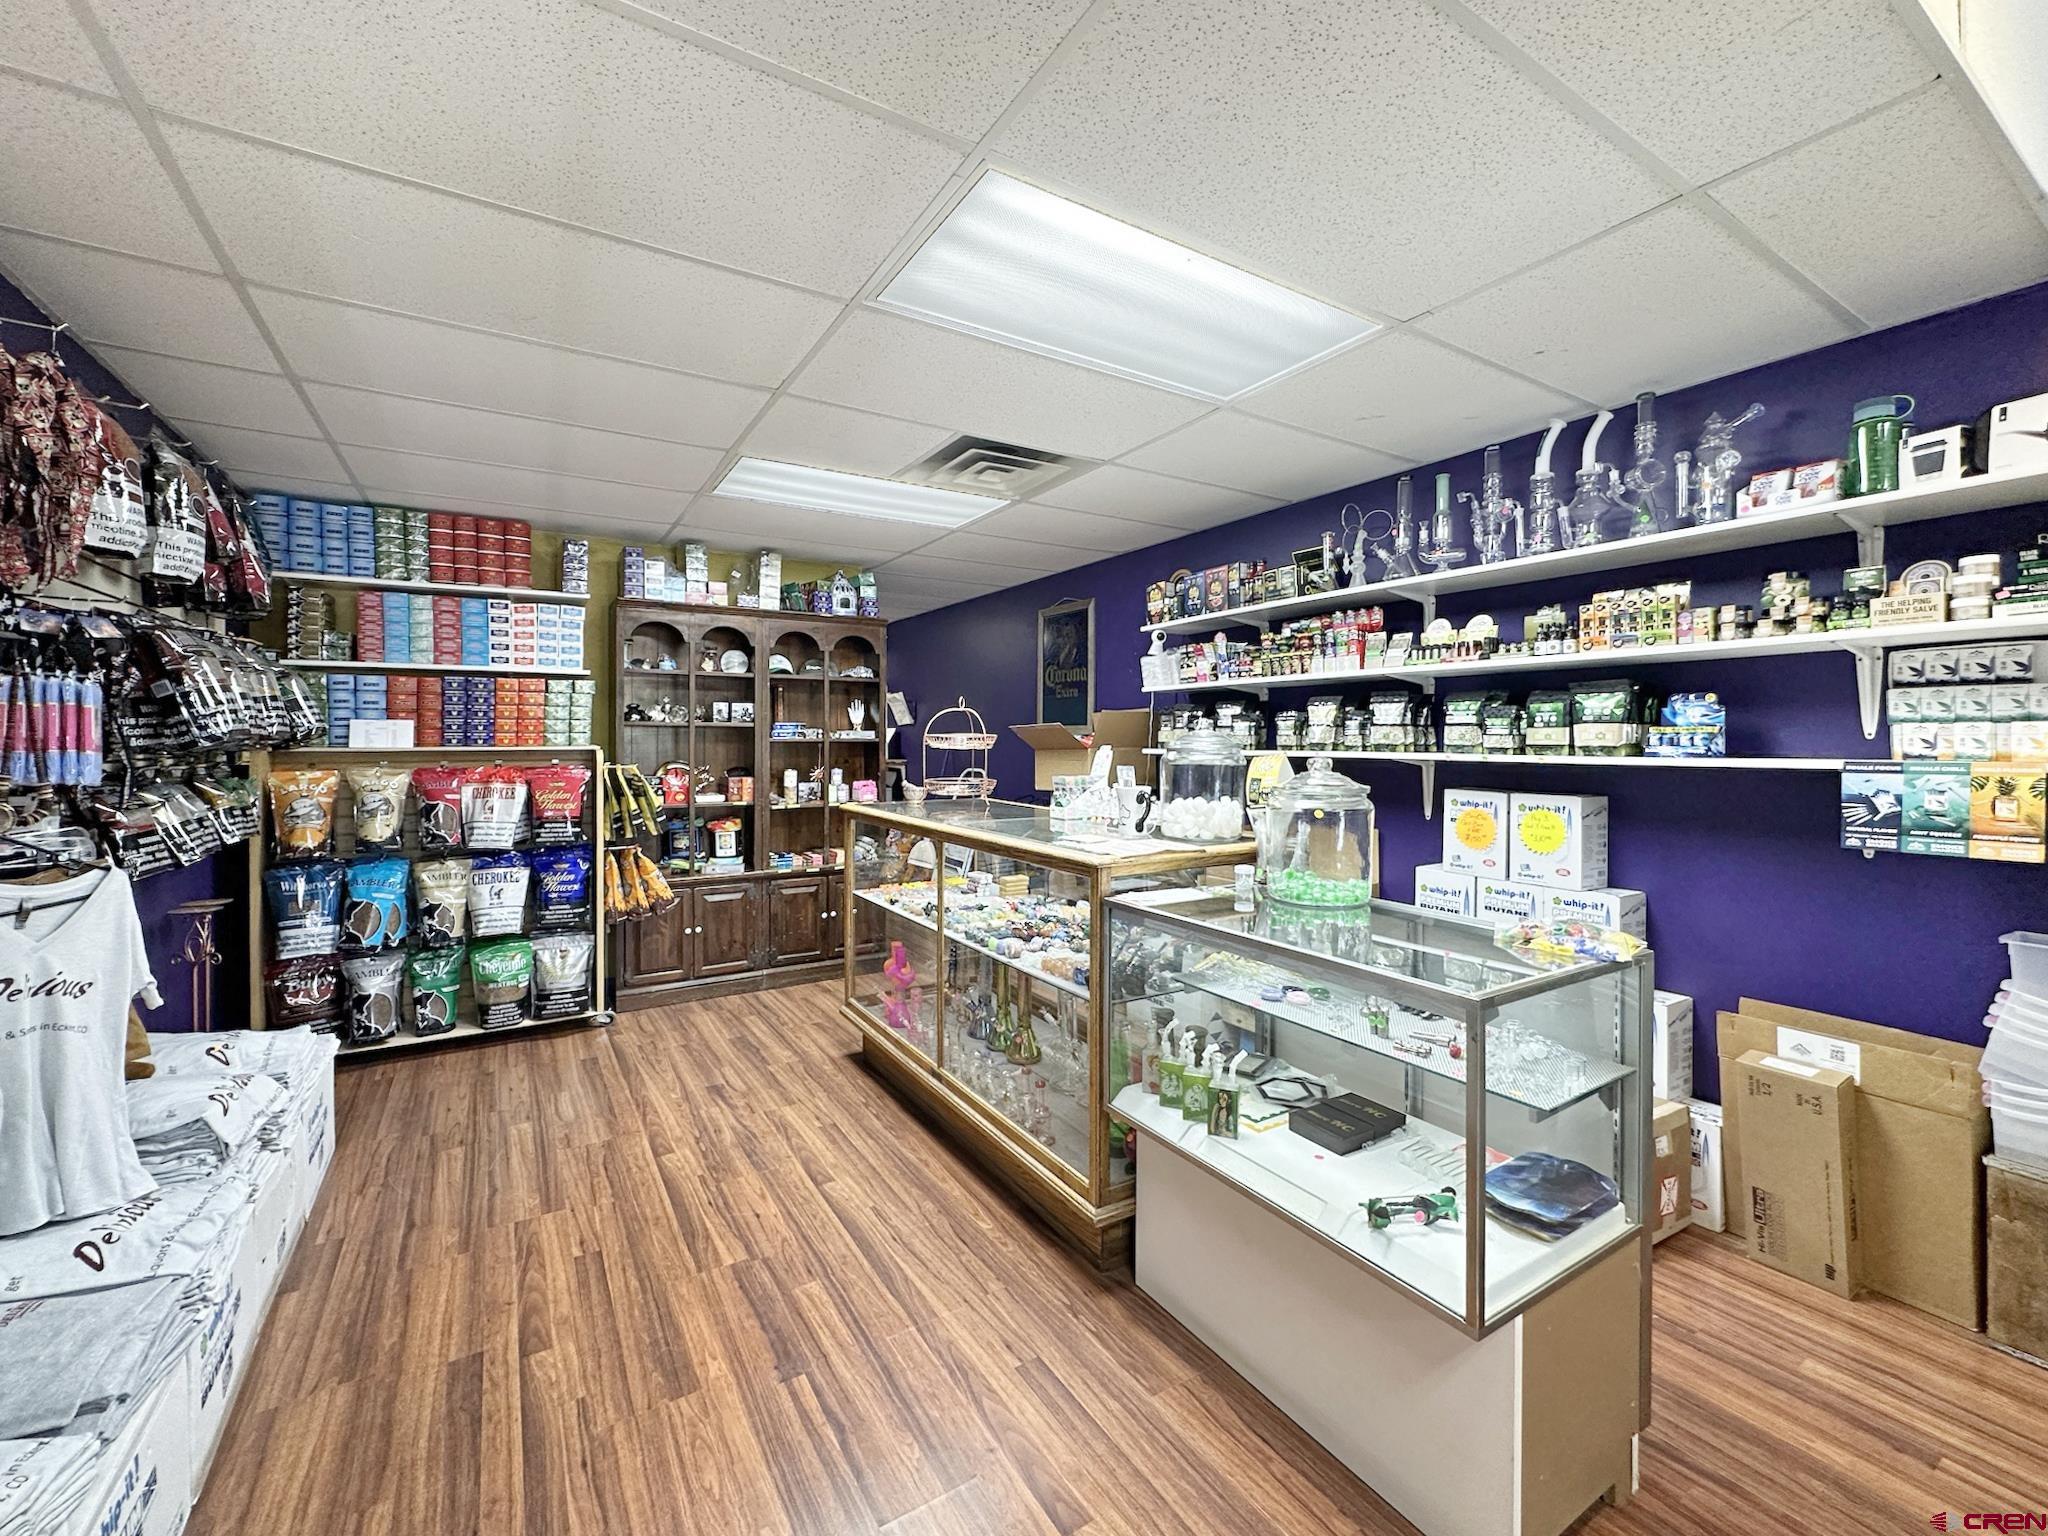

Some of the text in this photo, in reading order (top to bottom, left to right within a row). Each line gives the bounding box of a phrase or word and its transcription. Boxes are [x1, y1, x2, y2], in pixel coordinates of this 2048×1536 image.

[1874, 604, 1939, 616] FRIENDLY SALVE
[1881, 601, 1896, 609] THE
[1045, 664, 1088, 688] Corona
[1056, 684, 1079, 698] Extra
[534, 788, 572, 801] Golden
[541, 871, 576, 882] Golden
[1563, 897, 1605, 912] whip-it!
[1484, 905, 1530, 918] BUTANE
